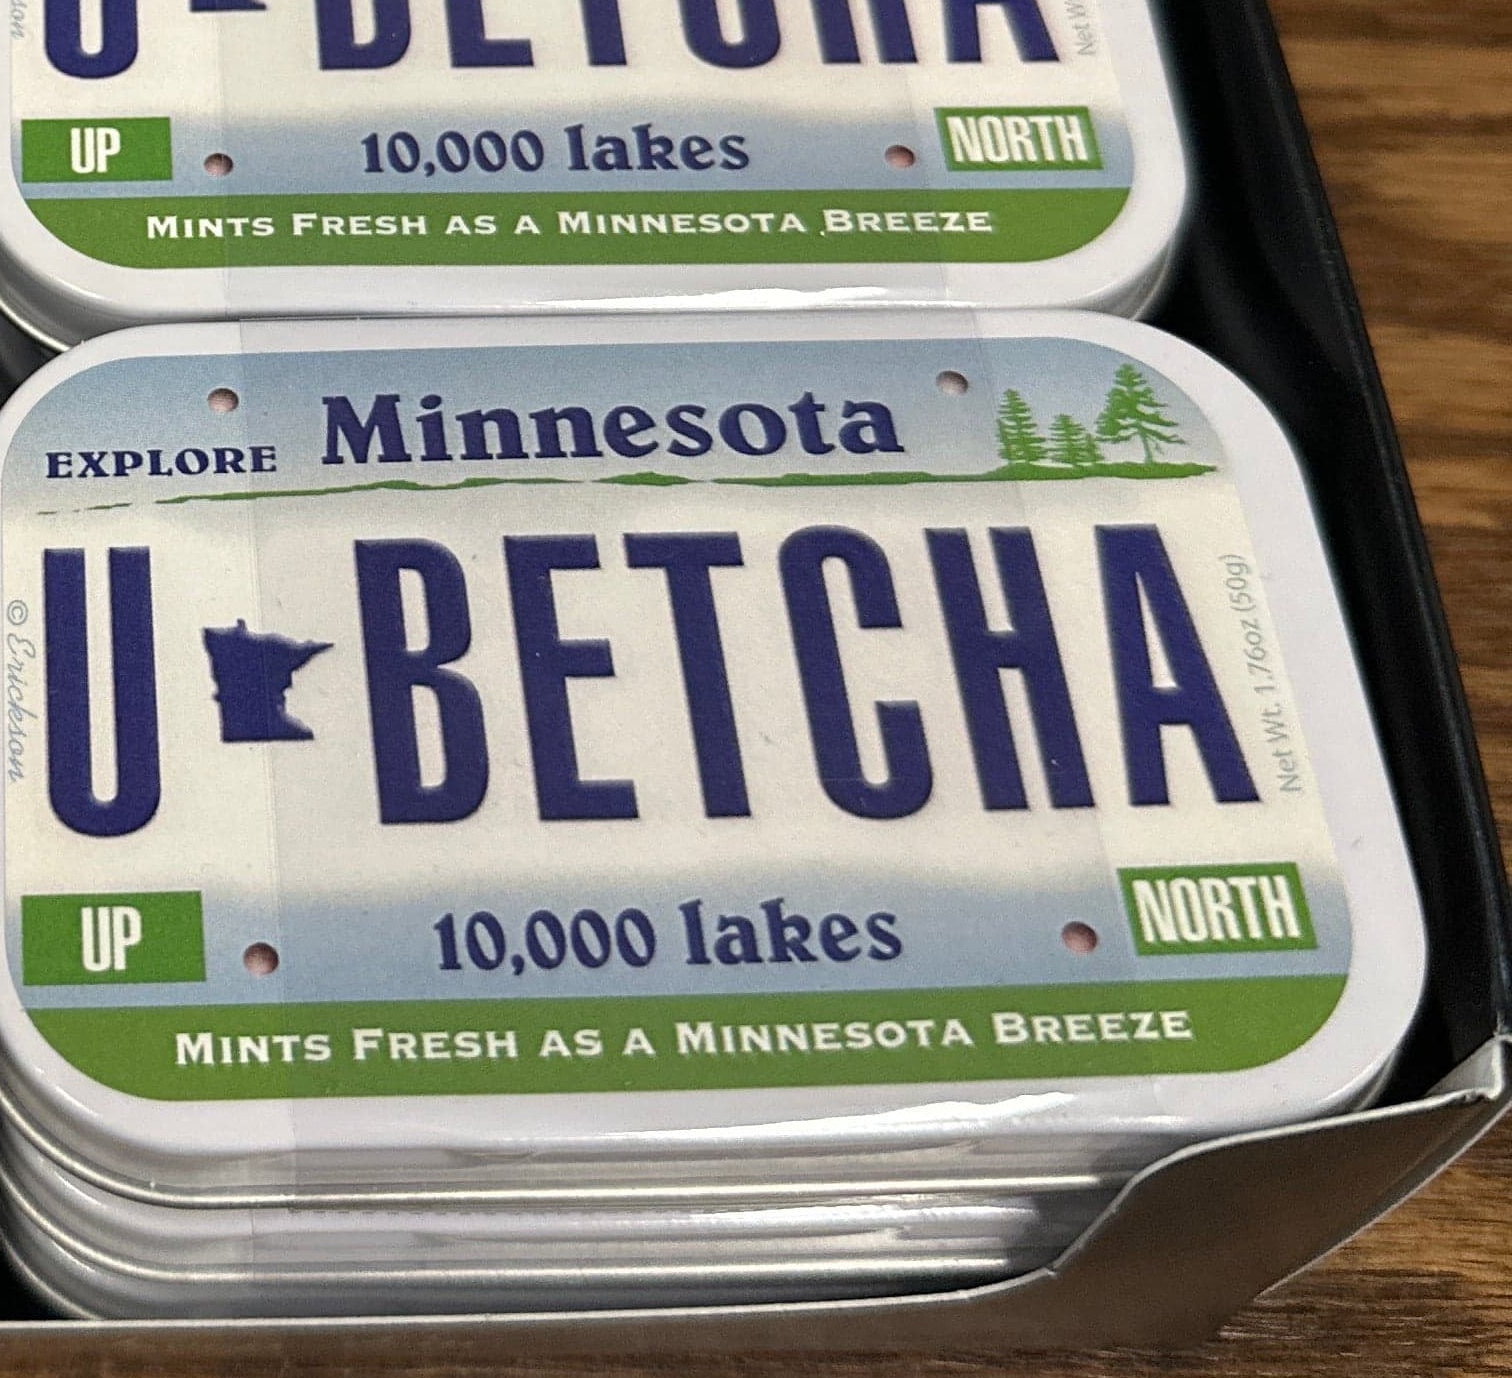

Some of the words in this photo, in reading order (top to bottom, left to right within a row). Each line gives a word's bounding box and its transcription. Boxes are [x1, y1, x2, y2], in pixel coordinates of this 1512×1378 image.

[1074, 24, 1097, 56] Net
[70, 127, 121, 174] UP
[361, 130, 545, 177] 10,000
[564, 123, 749, 171] lakes
[948, 115, 1088, 163] NORTH
[46, 446, 278, 478] EXPLORE
[321, 391, 904, 466] Minnesota
[1217, 553, 1257, 613] (50g)
[43, 546, 162, 838] U
[353, 523, 1260, 826] BETCHA
[1238, 616, 1279, 695] 1.76oz
[1257, 701, 1289, 746] Wt.
[1273, 750, 1303, 793] Net
[434, 910, 657, 977] 10,000
[677, 897, 903, 966] lakes
[1132, 874, 1300, 944] NORTH
[80, 906, 142, 973] UP
